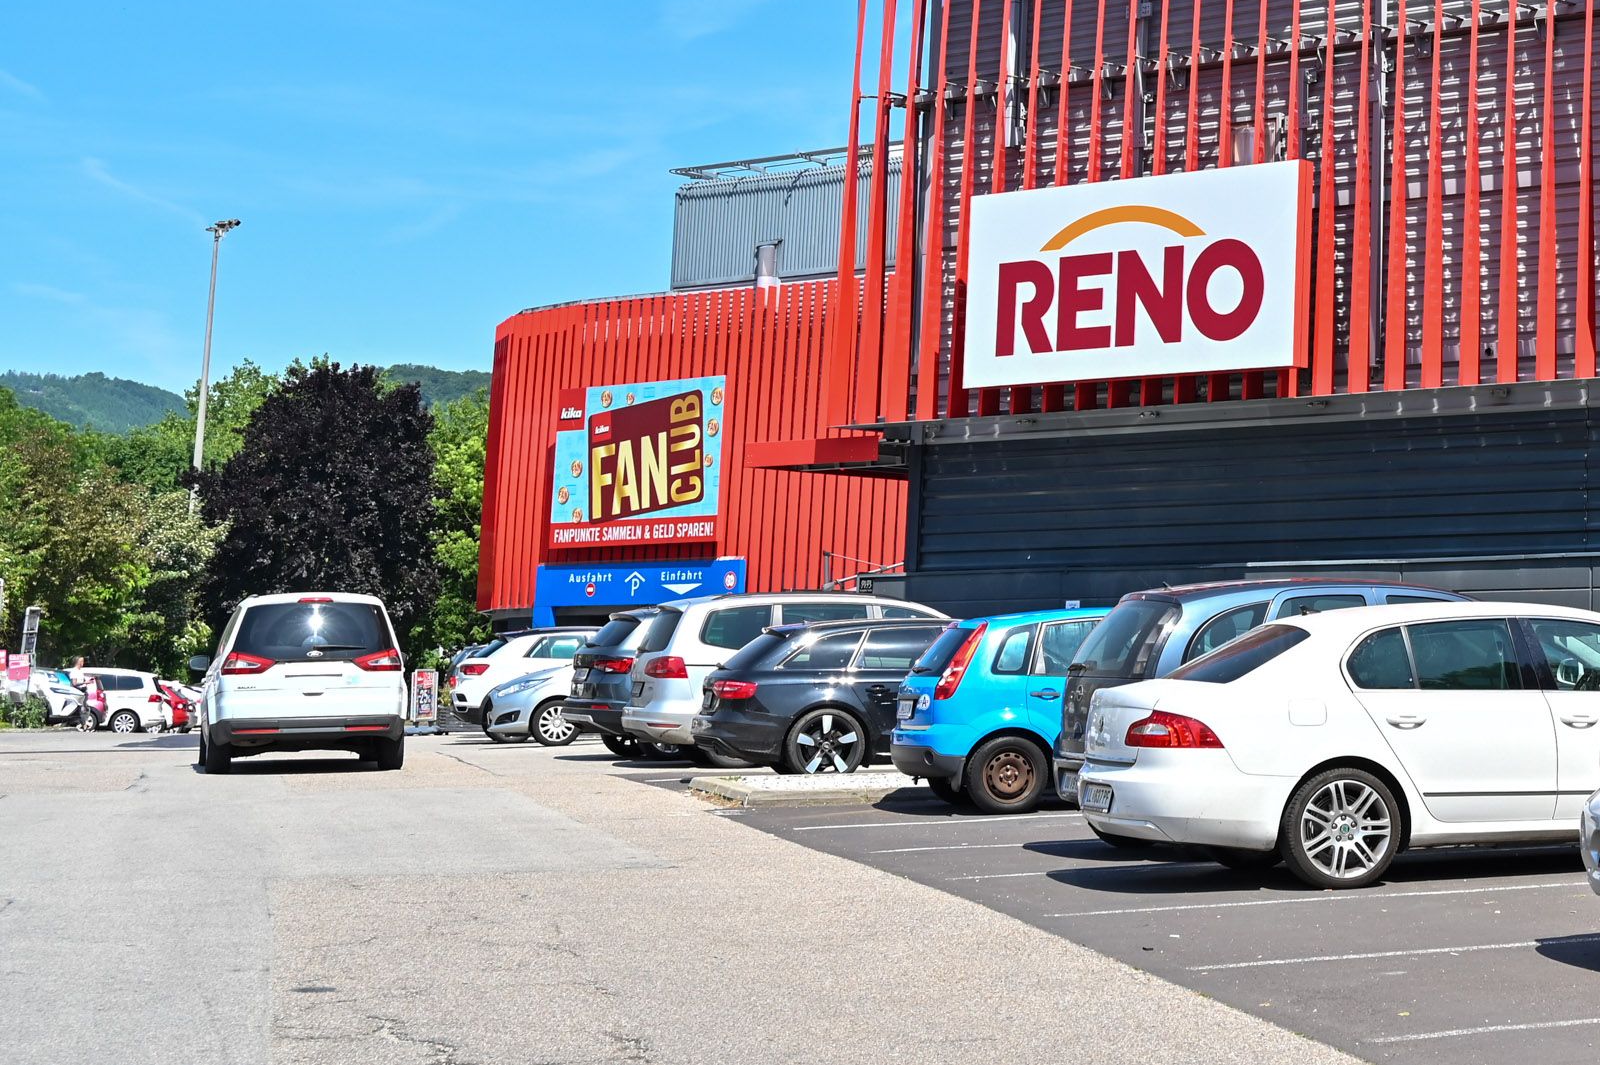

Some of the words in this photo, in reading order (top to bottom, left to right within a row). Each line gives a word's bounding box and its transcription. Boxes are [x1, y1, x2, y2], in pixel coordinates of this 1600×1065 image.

[995, 238, 1265, 357] RENO
[561, 407, 583, 420] kika
[595, 425, 610, 435] kika
[670, 394, 702, 503] CLUB
[592, 432, 668, 519] FAN
[554, 527, 600, 543] FANPUNKTE
[602, 525, 642, 541] SAMMELN
[644, 525, 651, 538] &
[653, 523, 675, 539] GELD
[677, 521, 714, 538] SPAREN!
[568, 572, 612, 583] Ausfahrt
[660, 570, 702, 581] Einfahrt
